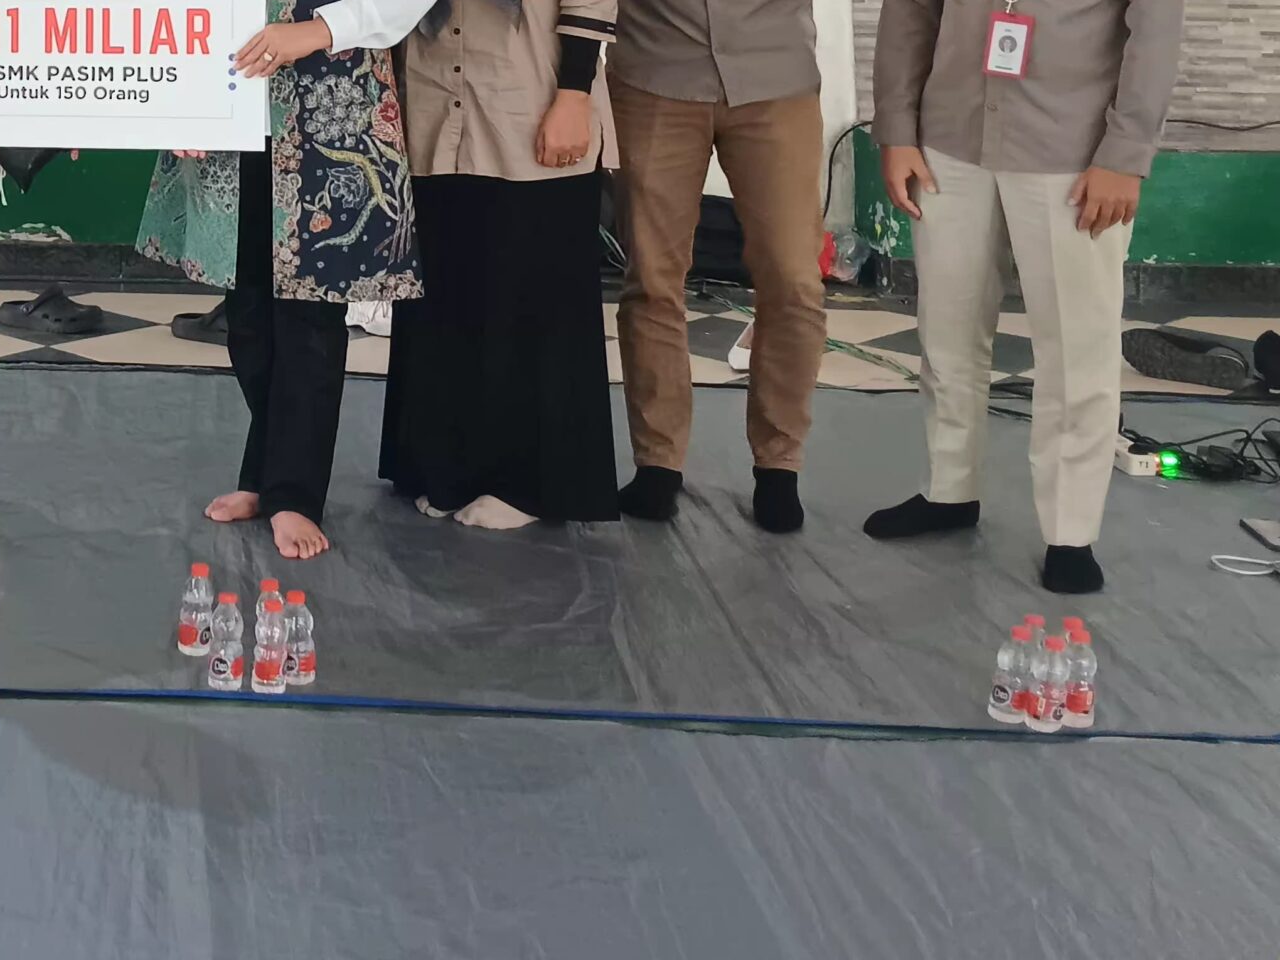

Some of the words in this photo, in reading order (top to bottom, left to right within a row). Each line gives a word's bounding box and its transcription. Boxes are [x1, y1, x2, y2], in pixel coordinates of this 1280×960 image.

[44, 7, 211, 55] MILIAR
[47, 65, 114, 82] PASIM
[122, 66, 178, 83] PLUS
[55, 85, 87, 100] 150
[93, 85, 150, 104] Orang
